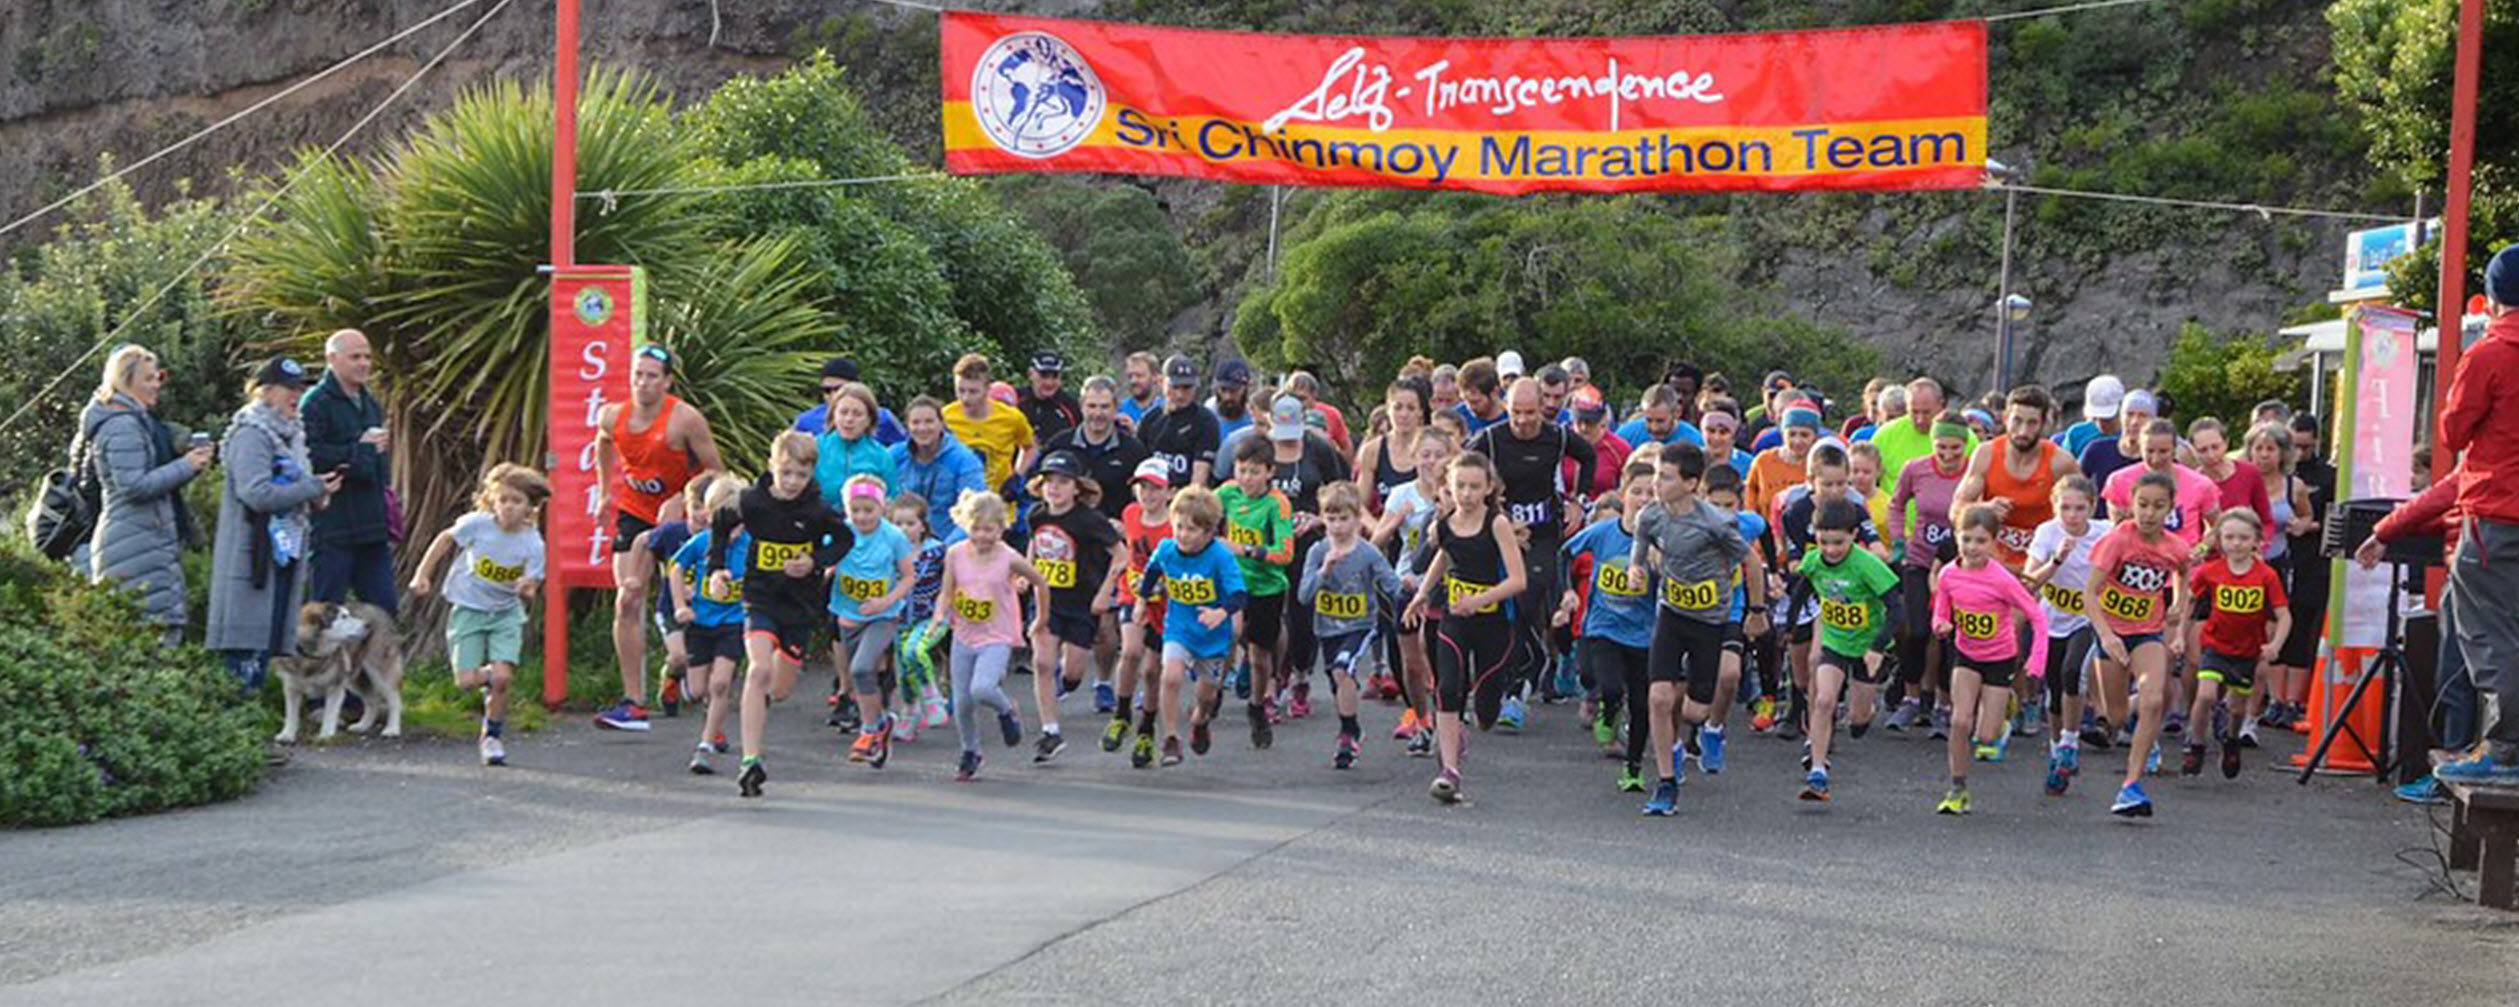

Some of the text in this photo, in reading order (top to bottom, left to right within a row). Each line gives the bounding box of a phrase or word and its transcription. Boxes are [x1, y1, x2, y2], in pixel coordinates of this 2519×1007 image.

[1264, 46, 1724, 133] Self-Transcendence
[1115, 107, 1967, 184] Sri Chinmoy Marathon Team
[1511, 502, 1545, 523] 811
[1320, 593, 1361, 615] 910
[1671, 583, 1713, 607] 990
[2105, 588, 2151, 618] 968
[2220, 588, 2262, 609] 902
[1822, 601, 1863, 626] 988
